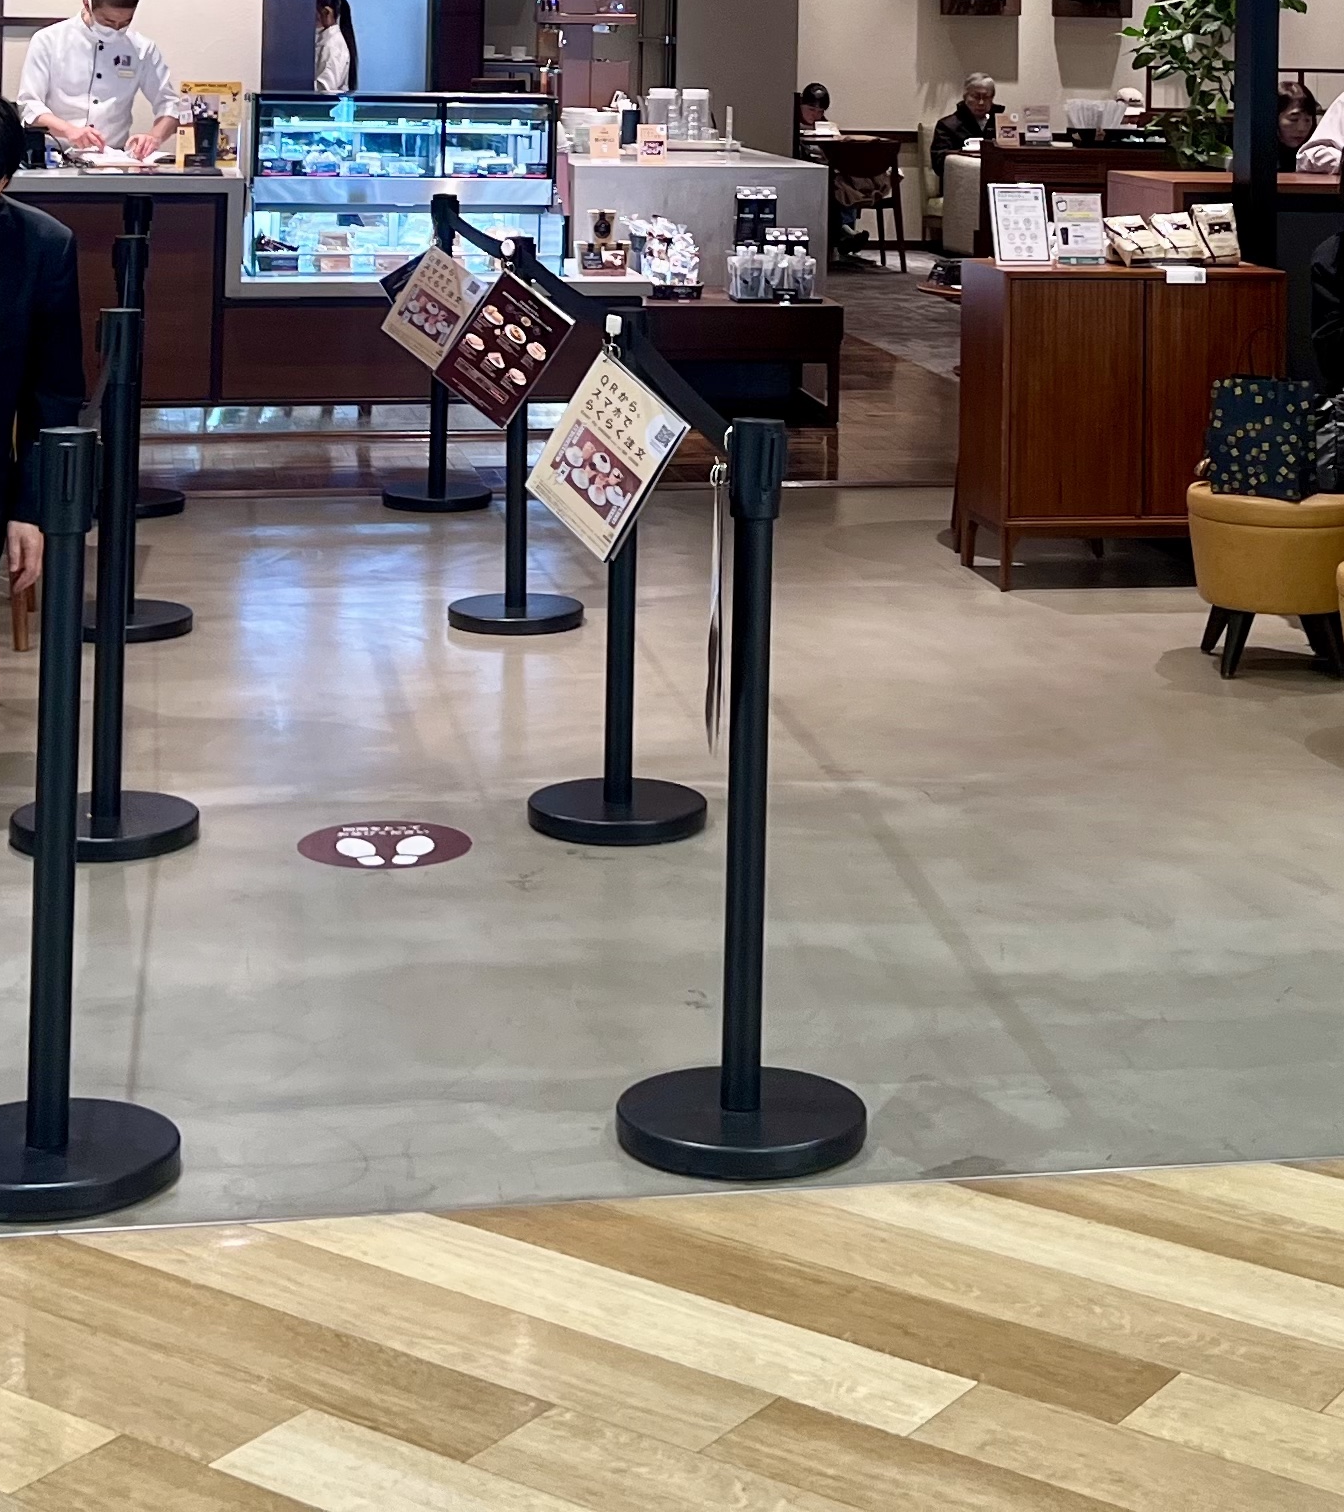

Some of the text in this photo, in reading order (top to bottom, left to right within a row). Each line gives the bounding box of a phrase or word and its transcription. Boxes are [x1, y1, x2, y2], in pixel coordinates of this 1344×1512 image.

[585, 399, 646, 460] らくらく注文
[592, 388, 633, 428] スマホで
